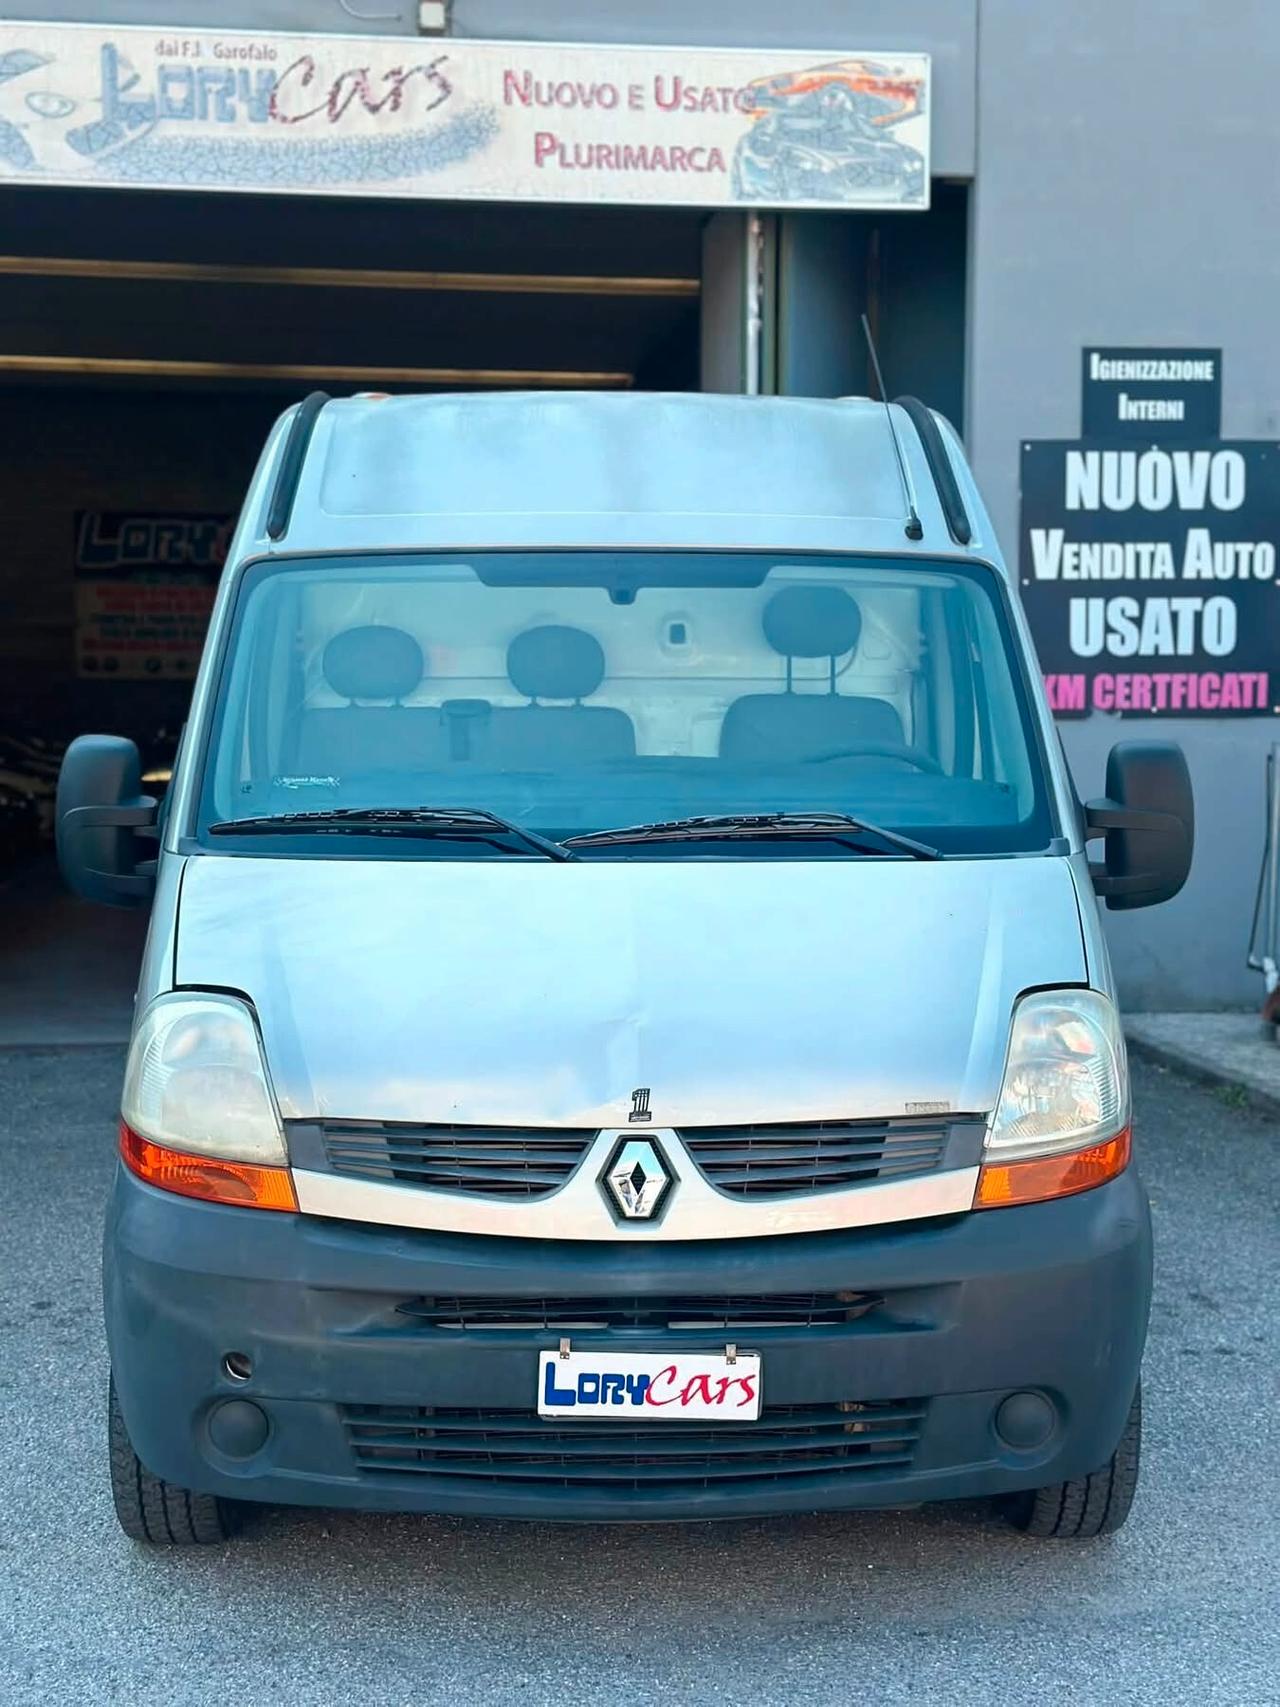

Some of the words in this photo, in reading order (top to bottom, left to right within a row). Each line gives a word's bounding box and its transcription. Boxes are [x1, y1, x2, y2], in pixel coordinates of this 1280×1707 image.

[213, 42, 278, 60] Garofalo
[502, 69, 619, 110] NUOVO
[628, 86, 644, 109] E
[654, 75, 756, 114] USATO
[533, 132, 726, 173] PLURIMARCA
[1090, 353, 1214, 381] IGIENIZZAZIONE
[1118, 393, 1185, 421] INTERNI
[1065, 450, 1246, 511] NUOVO
[1030, 529, 1175, 581] VENDITA
[1182, 527, 1275, 581] AUTO
[1069, 596, 1237, 656] USATO
[1093, 672, 1268, 710] CERTFICATI
